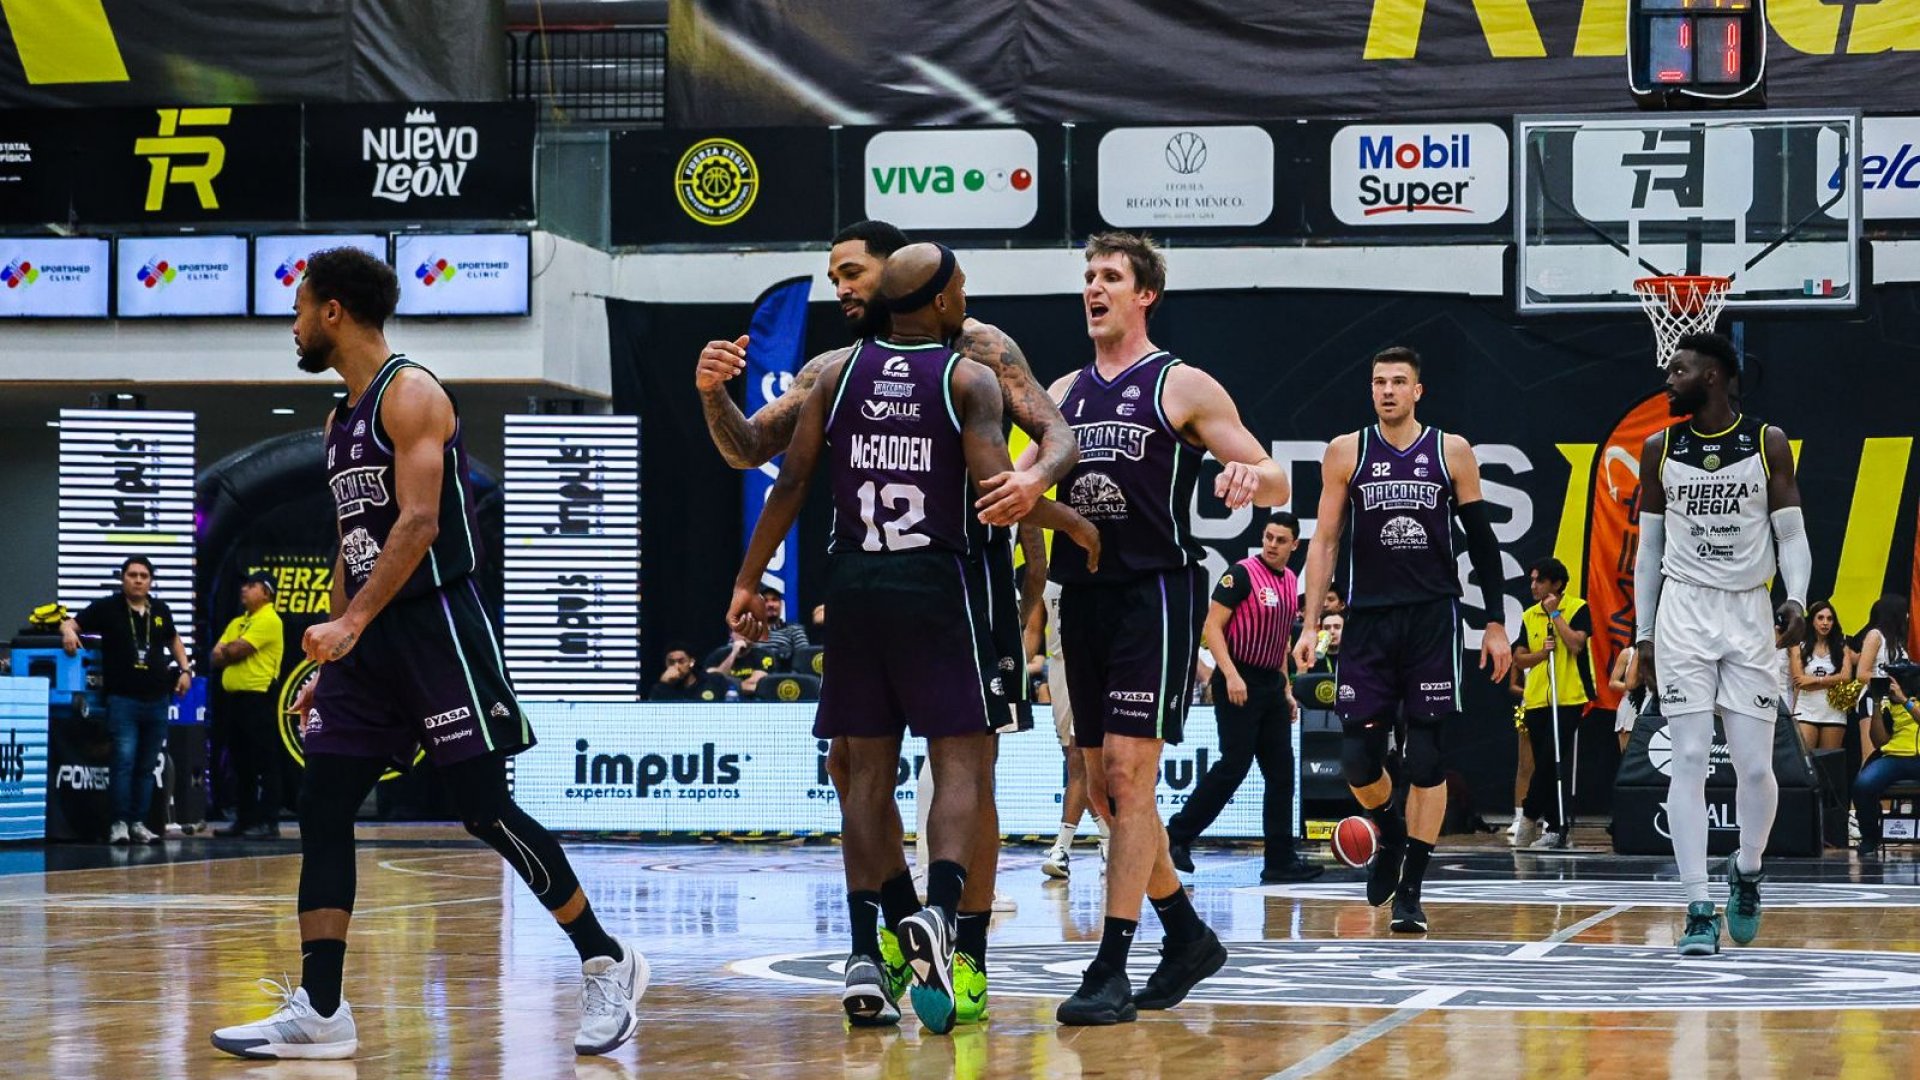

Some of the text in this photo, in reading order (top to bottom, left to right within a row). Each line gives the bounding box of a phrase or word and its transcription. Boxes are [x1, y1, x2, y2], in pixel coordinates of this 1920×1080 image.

[1358, 134, 1470, 169] Mobil
[1175, 198, 1190, 208] DE
[1358, 175, 1469, 212] Super
[1075, 398, 1085, 418] 1
[850, 434, 932, 472] McFADDEN
[1372, 462, 1391, 477] 32
[1365, 484, 1435, 507] HALCONES
[1678, 483, 1749, 501] FUERZA
[857, 480, 931, 551] 12
[1686, 499, 1741, 516] REGIA
[275, 591, 331, 614] EGIA
[575, 738, 740, 797] impuls
[565, 786, 740, 803] expertos en zapatos
[896, 790, 914, 799] en
